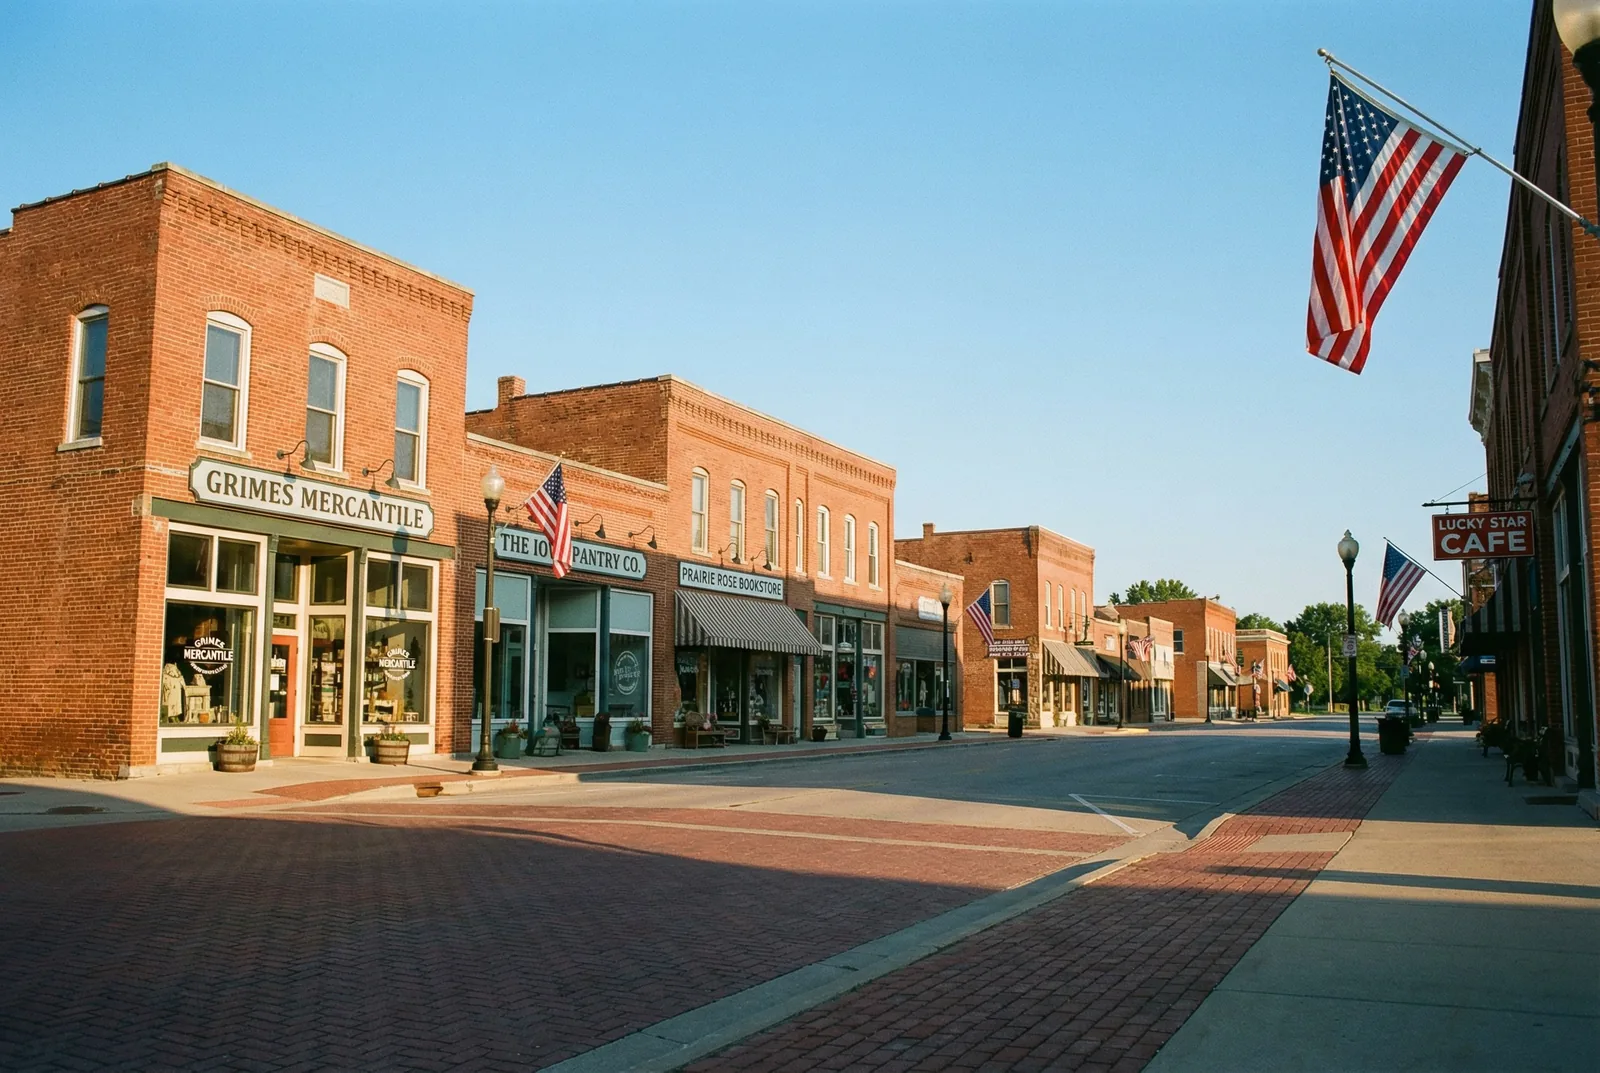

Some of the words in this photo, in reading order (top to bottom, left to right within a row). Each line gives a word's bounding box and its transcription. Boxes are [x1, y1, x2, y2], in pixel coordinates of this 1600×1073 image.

[206, 470, 294, 506] GRIMES
[301, 487, 424, 529] MERCANTILE
[1439, 517, 1485, 531] LUCKY
[1490, 516, 1527, 529] STAR
[500, 532, 529, 555] THE
[533, 539, 553, 559] IO
[572, 545, 620, 570] PANTRY
[623, 555, 641, 574] CO.
[1440, 530, 1527, 554] CAFE
[682, 567, 715, 586] PRAIRIE
[717, 573, 738, 589] ROSE
[739, 577, 782, 596] BOOKSTORE
[183, 648, 234, 661] MERCANTILE
[378, 658, 416, 669] MERCANTILE
